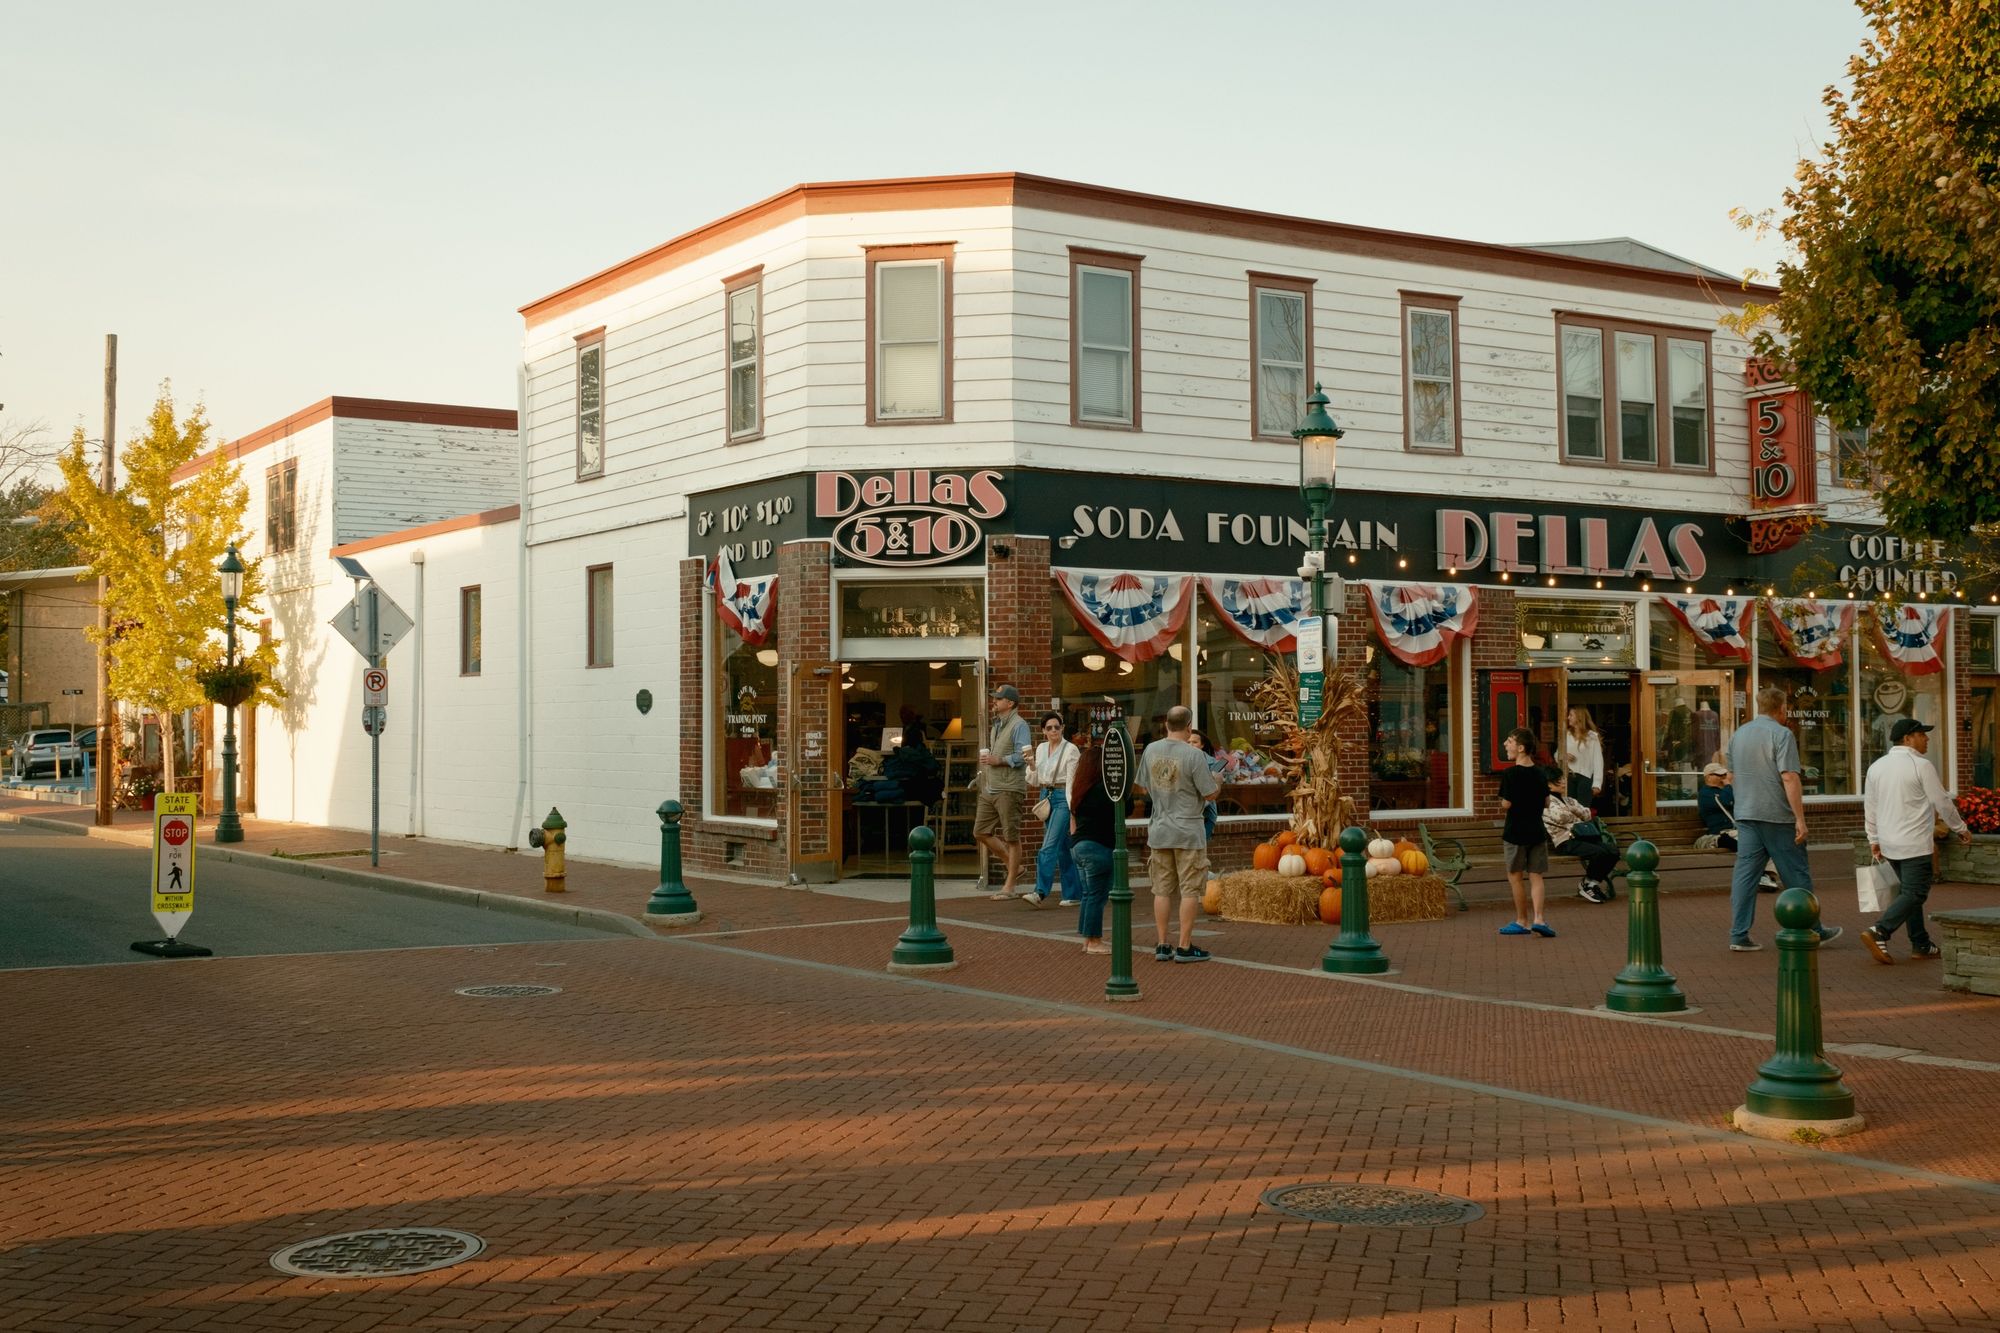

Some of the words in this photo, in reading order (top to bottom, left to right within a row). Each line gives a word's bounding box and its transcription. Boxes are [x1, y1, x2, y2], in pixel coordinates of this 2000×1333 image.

[1757, 400, 1784, 435] 5
[1760, 437, 1784, 461] &
[816, 469, 1007, 519] Dellas
[1754, 462, 1795, 498] 10
[697, 511, 714, 536] 5¢
[722, 504, 748, 533] 10¢
[757, 496, 792, 526] $1.00
[1073, 504, 1184, 541] SODA
[718, 543, 745, 562] ND
[752, 539, 772, 559] UP
[851, 515, 967, 557] 5&10
[1436, 509, 1706, 582] DELLAS
[728, 714, 751, 724] TRADING
[752, 714, 767, 724] POST
[1228, 712, 1268, 720] TRADING
[165, 796, 190, 804] STATE
[168, 805, 186, 813] LAW
[165, 828, 188, 838] STOP
